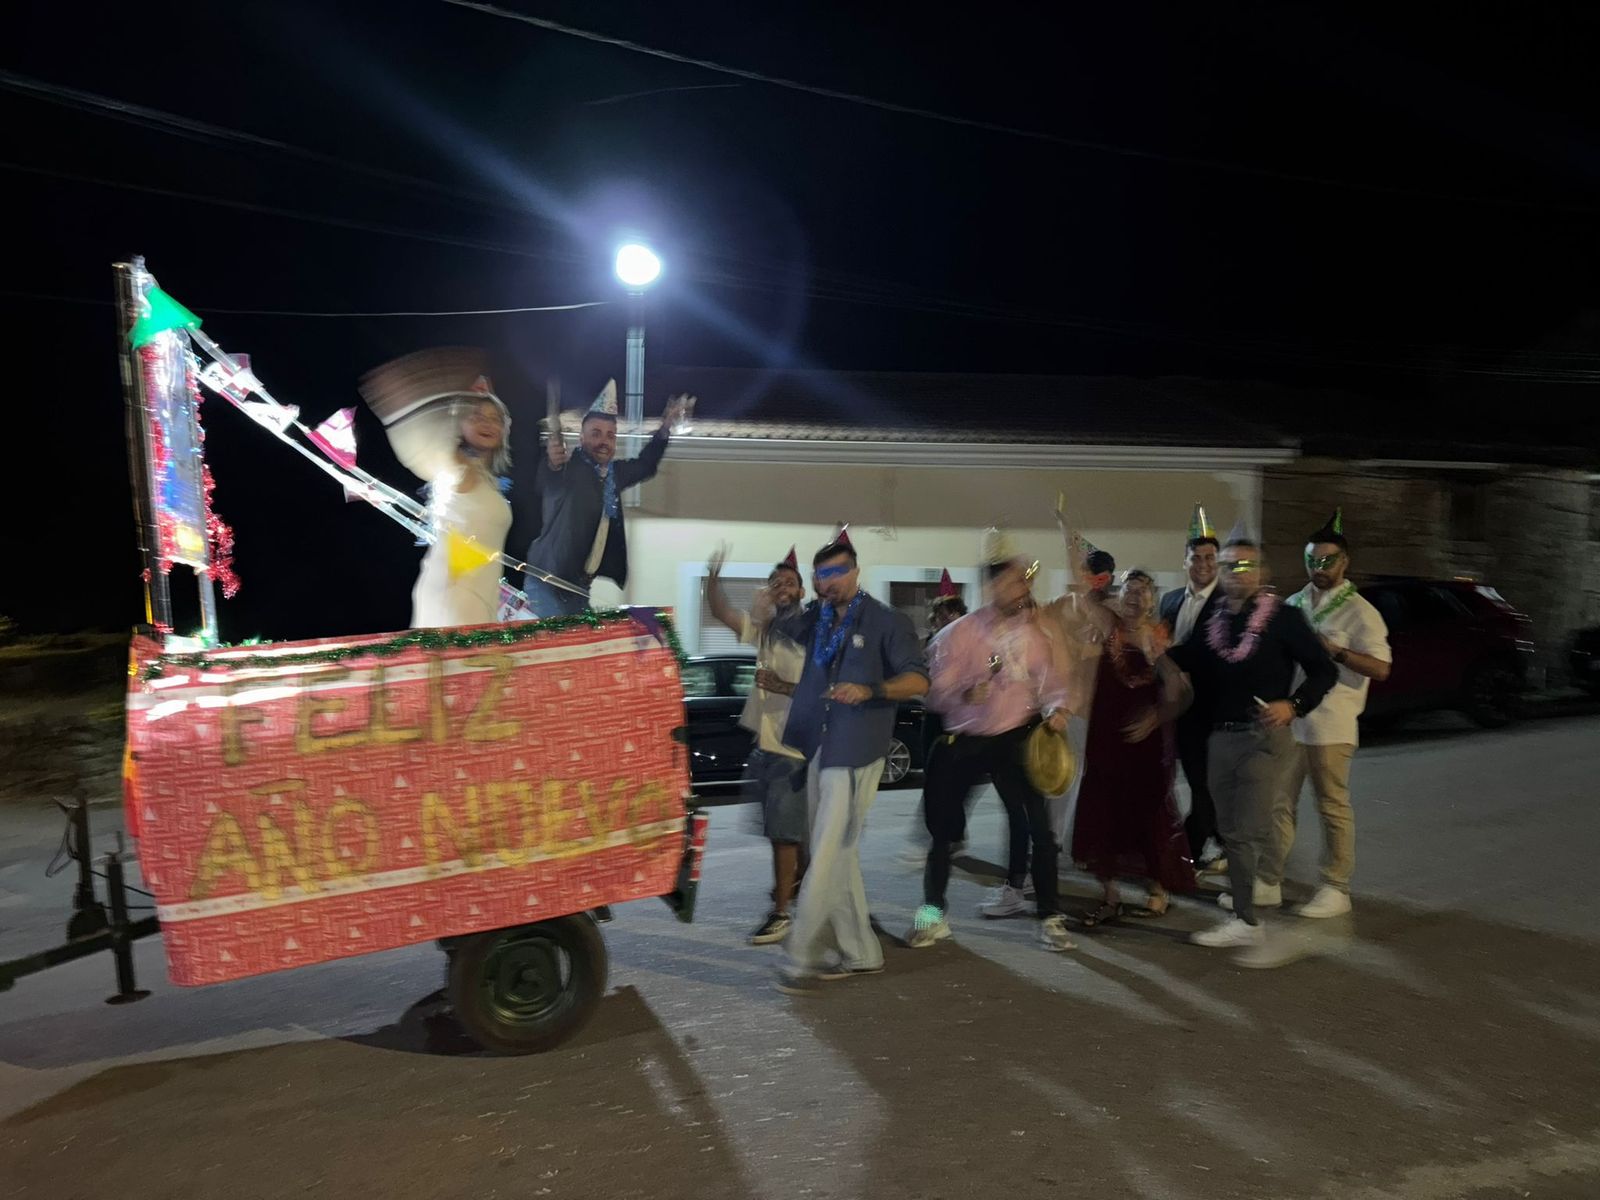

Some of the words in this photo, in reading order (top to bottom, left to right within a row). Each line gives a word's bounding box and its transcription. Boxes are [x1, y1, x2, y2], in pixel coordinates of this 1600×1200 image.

[220, 653, 522, 766] FELIZ
[189, 778, 381, 900] AÑO
[422, 778, 669, 878] NUEVO
